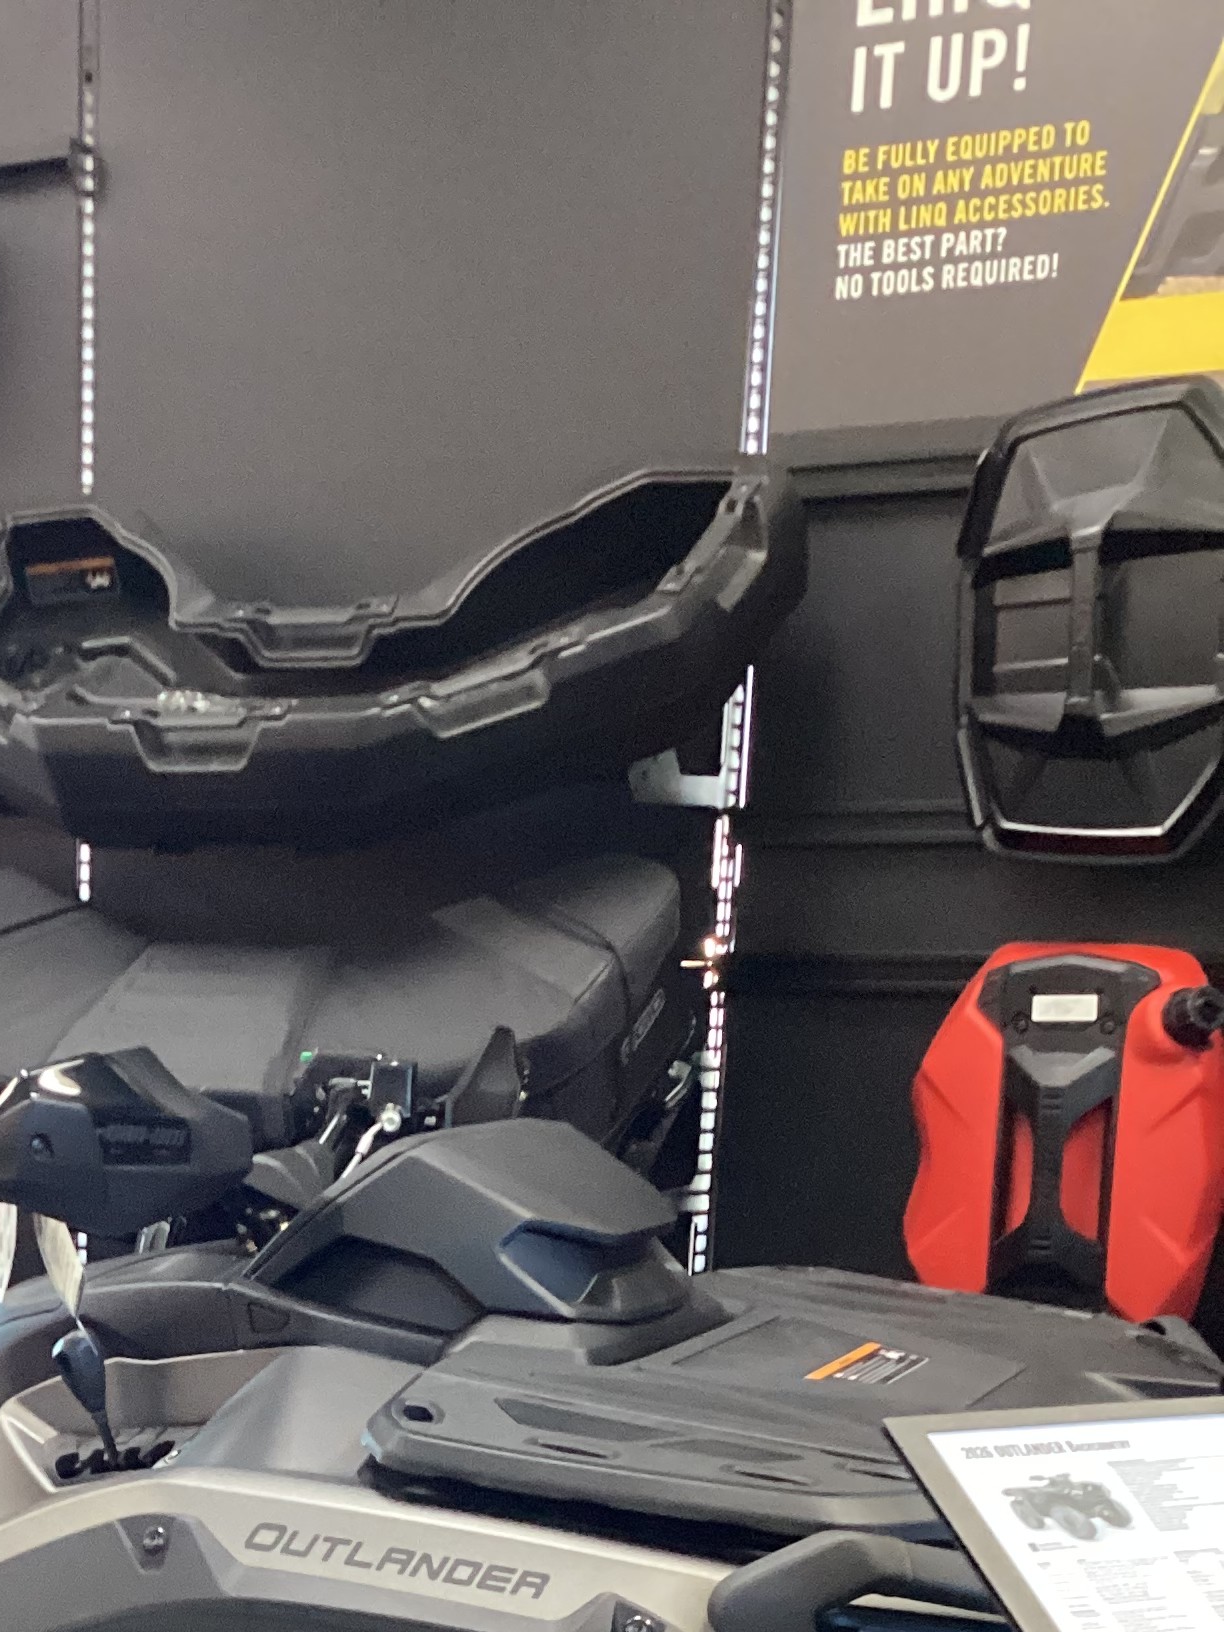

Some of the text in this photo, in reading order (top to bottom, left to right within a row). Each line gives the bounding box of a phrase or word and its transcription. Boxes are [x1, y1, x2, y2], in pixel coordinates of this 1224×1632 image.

[851, 23, 1031, 113] IT UP!
[842, 119, 1091, 175] BE FULLY EQUIPPED TO
[841, 150, 1108, 206] TAKE ON ANY ADVENTURE
[838, 183, 1110, 238] WITH LINQ ACCESSORIES.
[837, 226, 1008, 269] THE BEST PART?
[834, 253, 1059, 301] NO TOOLS REQUIRED!
[244, 1521, 551, 1600] OUTLANDER
